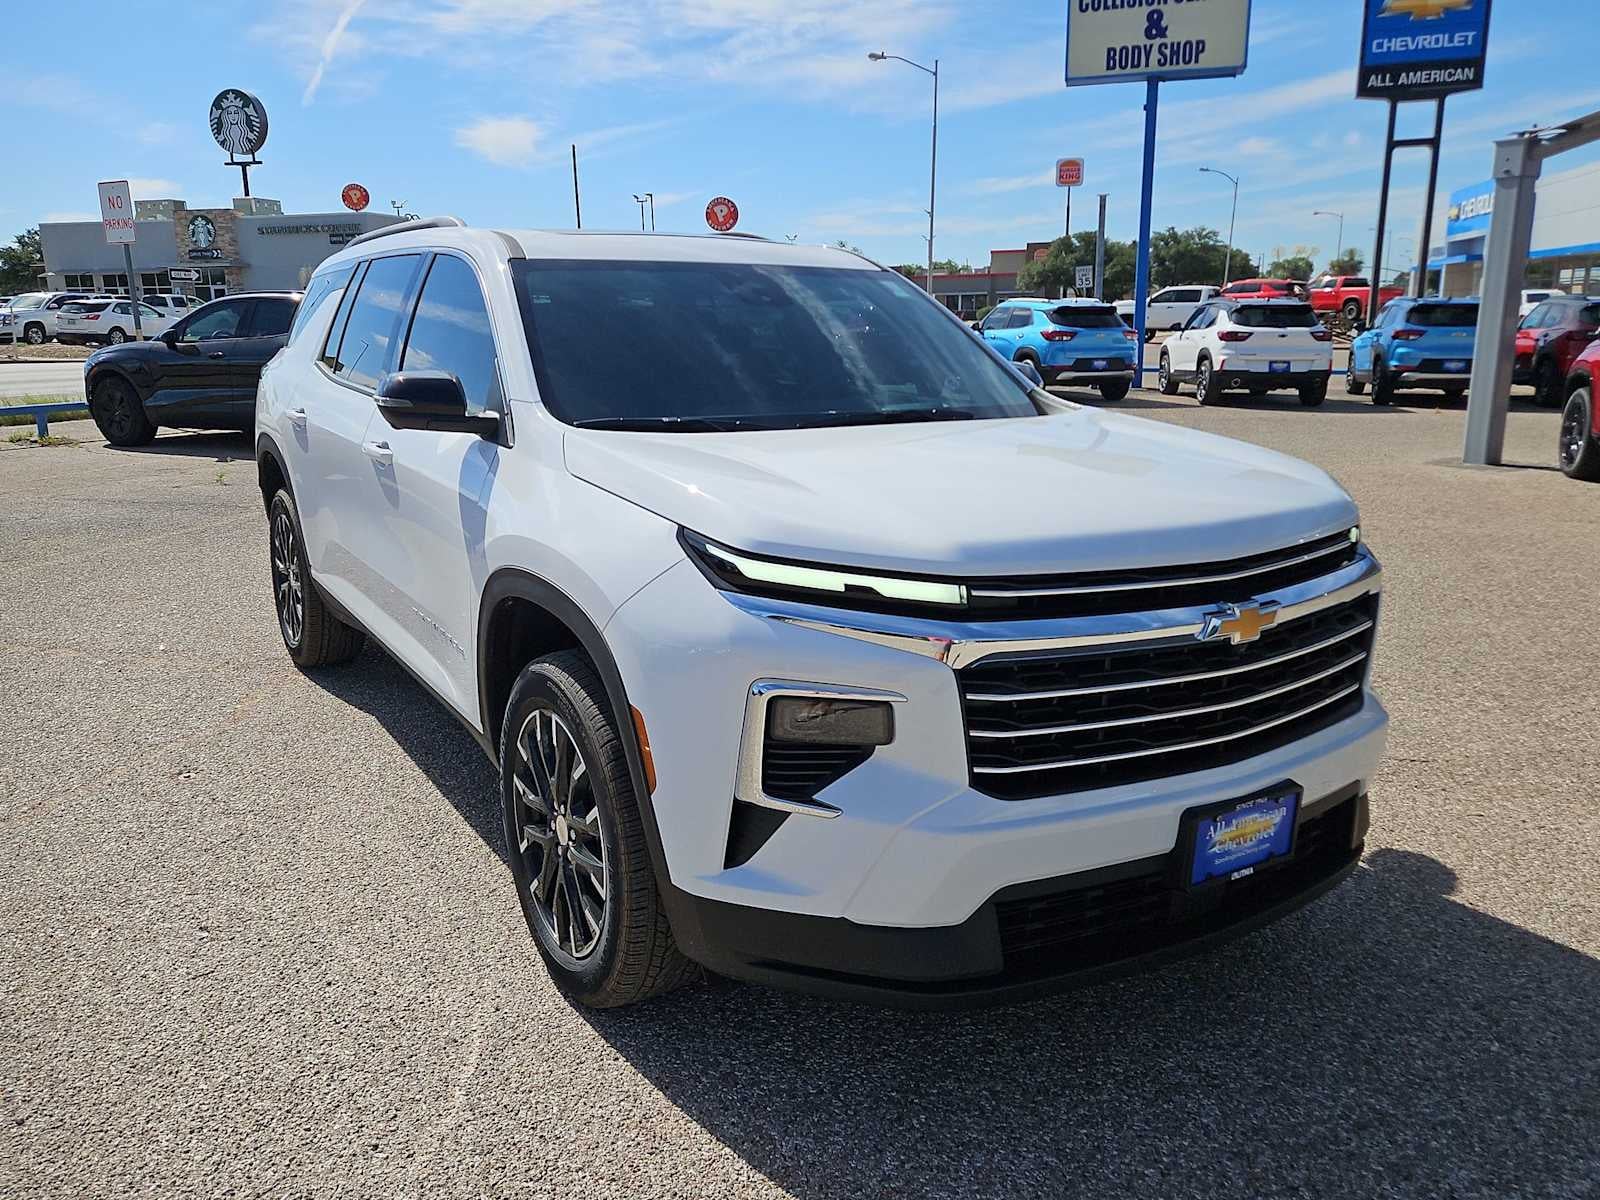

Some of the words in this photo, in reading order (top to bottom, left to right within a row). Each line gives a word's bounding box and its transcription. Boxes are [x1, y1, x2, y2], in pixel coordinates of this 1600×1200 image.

[1144, 9, 1168, 40] &
[1371, 31, 1477, 53] CHEVROLET
[1106, 44, 1154, 71] BODY
[1157, 39, 1206, 67] SHOP
[1367, 73, 1394, 88] ALL
[1397, 67, 1474, 85] AMERICAN
[1059, 172, 1081, 180] KING
[107, 195, 123, 208] NO
[1460, 194, 1495, 219] CHEVROL
[104, 217, 133, 230] PARKING
[1078, 277, 1091, 286] 35
[1215, 826, 1275, 854] Chevrolet
